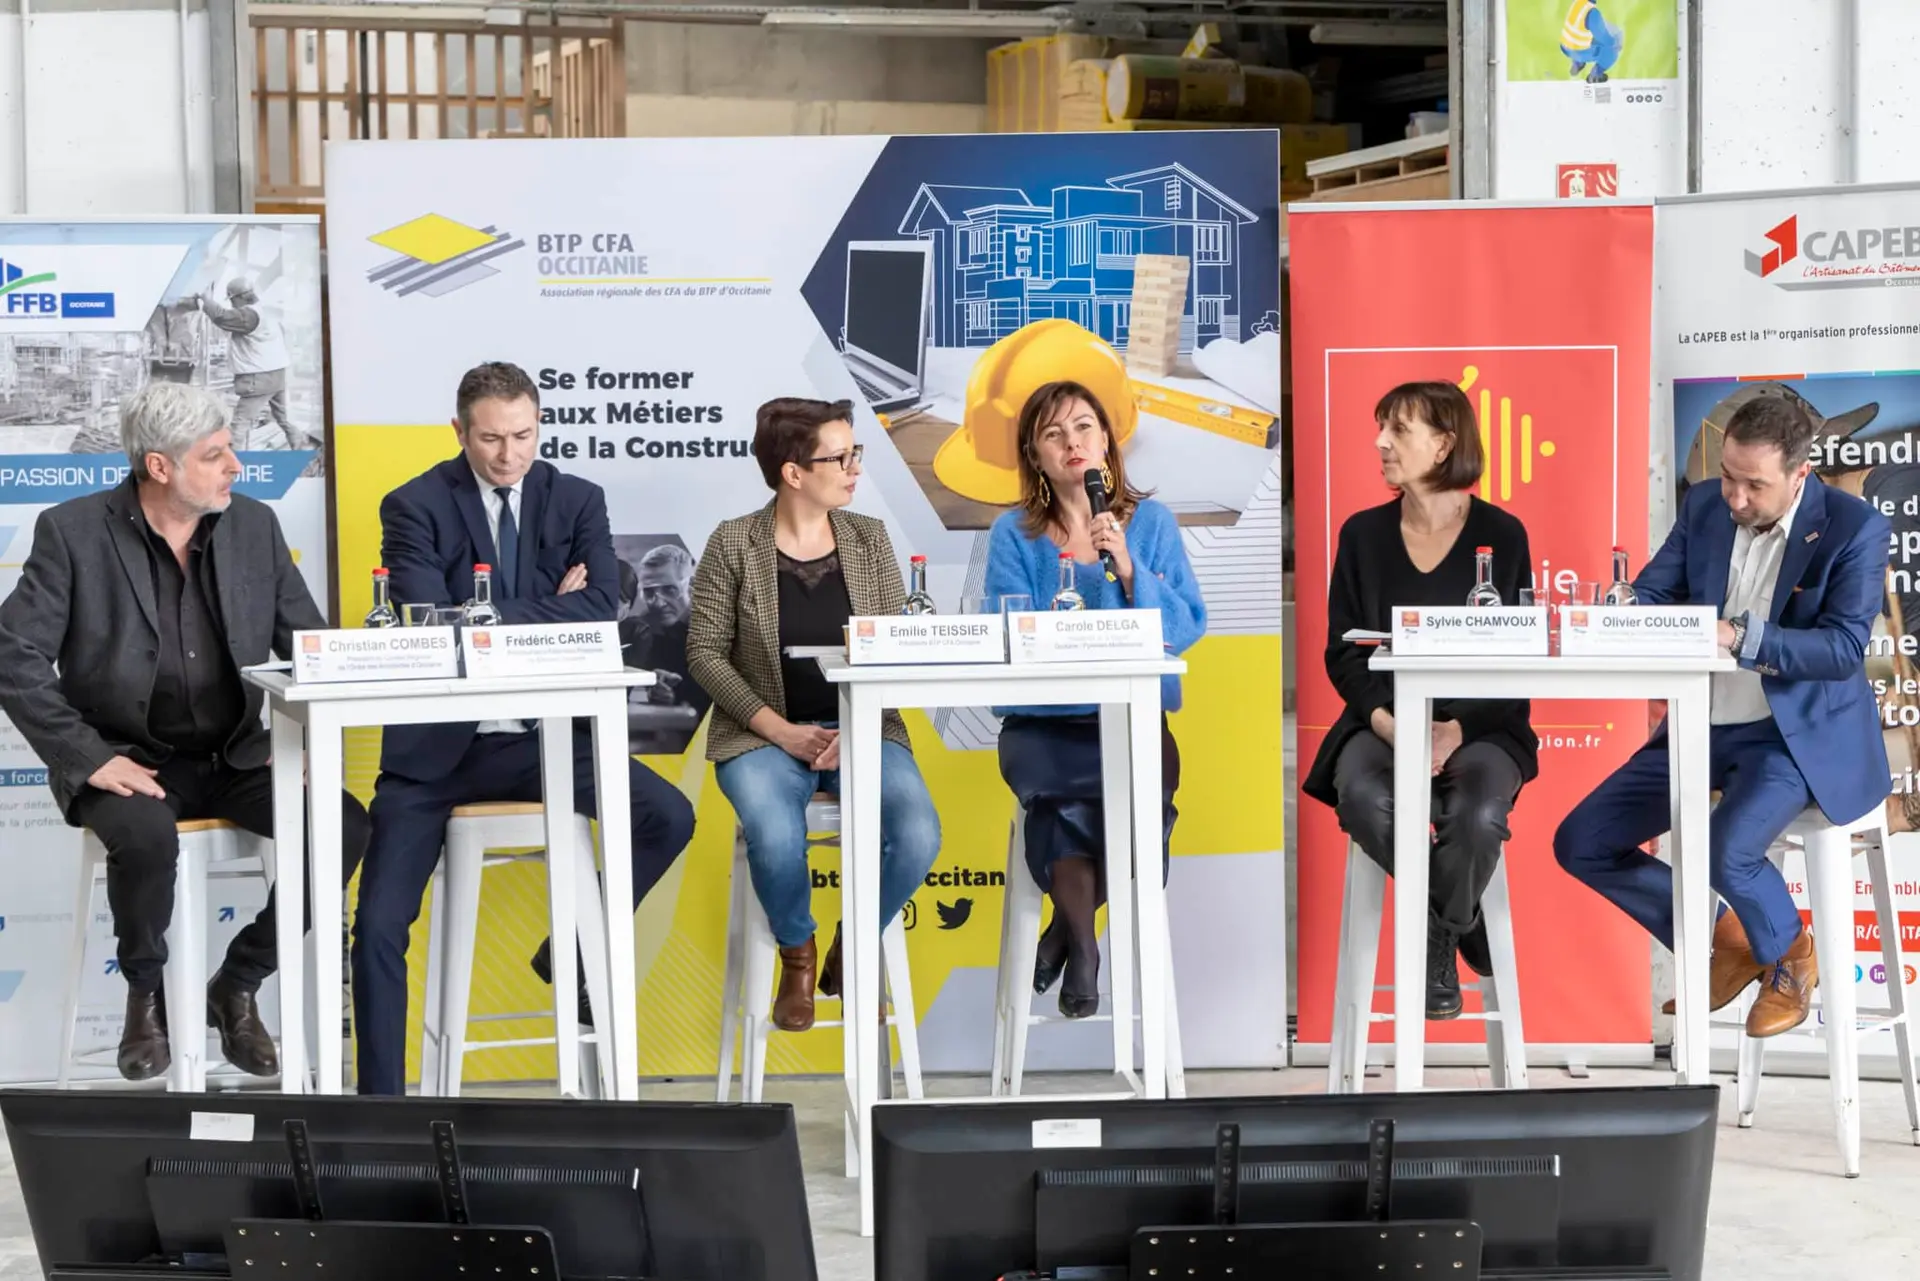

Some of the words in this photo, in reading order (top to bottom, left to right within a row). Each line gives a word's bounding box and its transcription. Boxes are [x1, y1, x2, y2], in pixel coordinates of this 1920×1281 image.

[538, 234, 582, 253] BTP
[592, 233, 634, 253] CFA
[1803, 226, 1920, 262] CAPEB
[538, 255, 649, 275] OCCITANIE
[540, 287, 594, 297] Association
[596, 287, 642, 299] régionale
[645, 286, 662, 296] des
[664, 286, 681, 296] CFA
[684, 286, 696, 296] du
[698, 286, 717, 296] BTP
[719, 285, 772, 296] d'Occitanie
[8, 293, 57, 313] FFB
[1678, 333, 1690, 344] La
[1693, 332, 1727, 343] CAPEB
[1730, 332, 1746, 342] est
[1750, 330, 1760, 341] la
[1779, 326, 1846, 341] organisation
[538, 367, 576, 390] Se
[585, 366, 694, 390] former
[540, 407, 597, 424] aux
[607, 400, 723, 424] Métiers
[540, 436, 579, 459] de
[589, 436, 616, 459] la
[1, 466, 95, 487] PASSION
[889, 625, 928, 637] Emilie
[931, 624, 989, 637] TEISSIER
[1055, 620, 1094, 632] Carole
[1096, 619, 1140, 631] DELGA
[1426, 616, 1462, 629] Sylvie
[1465, 615, 1537, 627] CHAMVOUX
[1602, 616, 1641, 628] Olivier
[1644, 616, 1700, 628] COULOM
[328, 639, 387, 652] Christian
[389, 637, 448, 650] COMBES
[506, 634, 555, 646] Frédéric
[558, 630, 603, 644] CARRÉ
